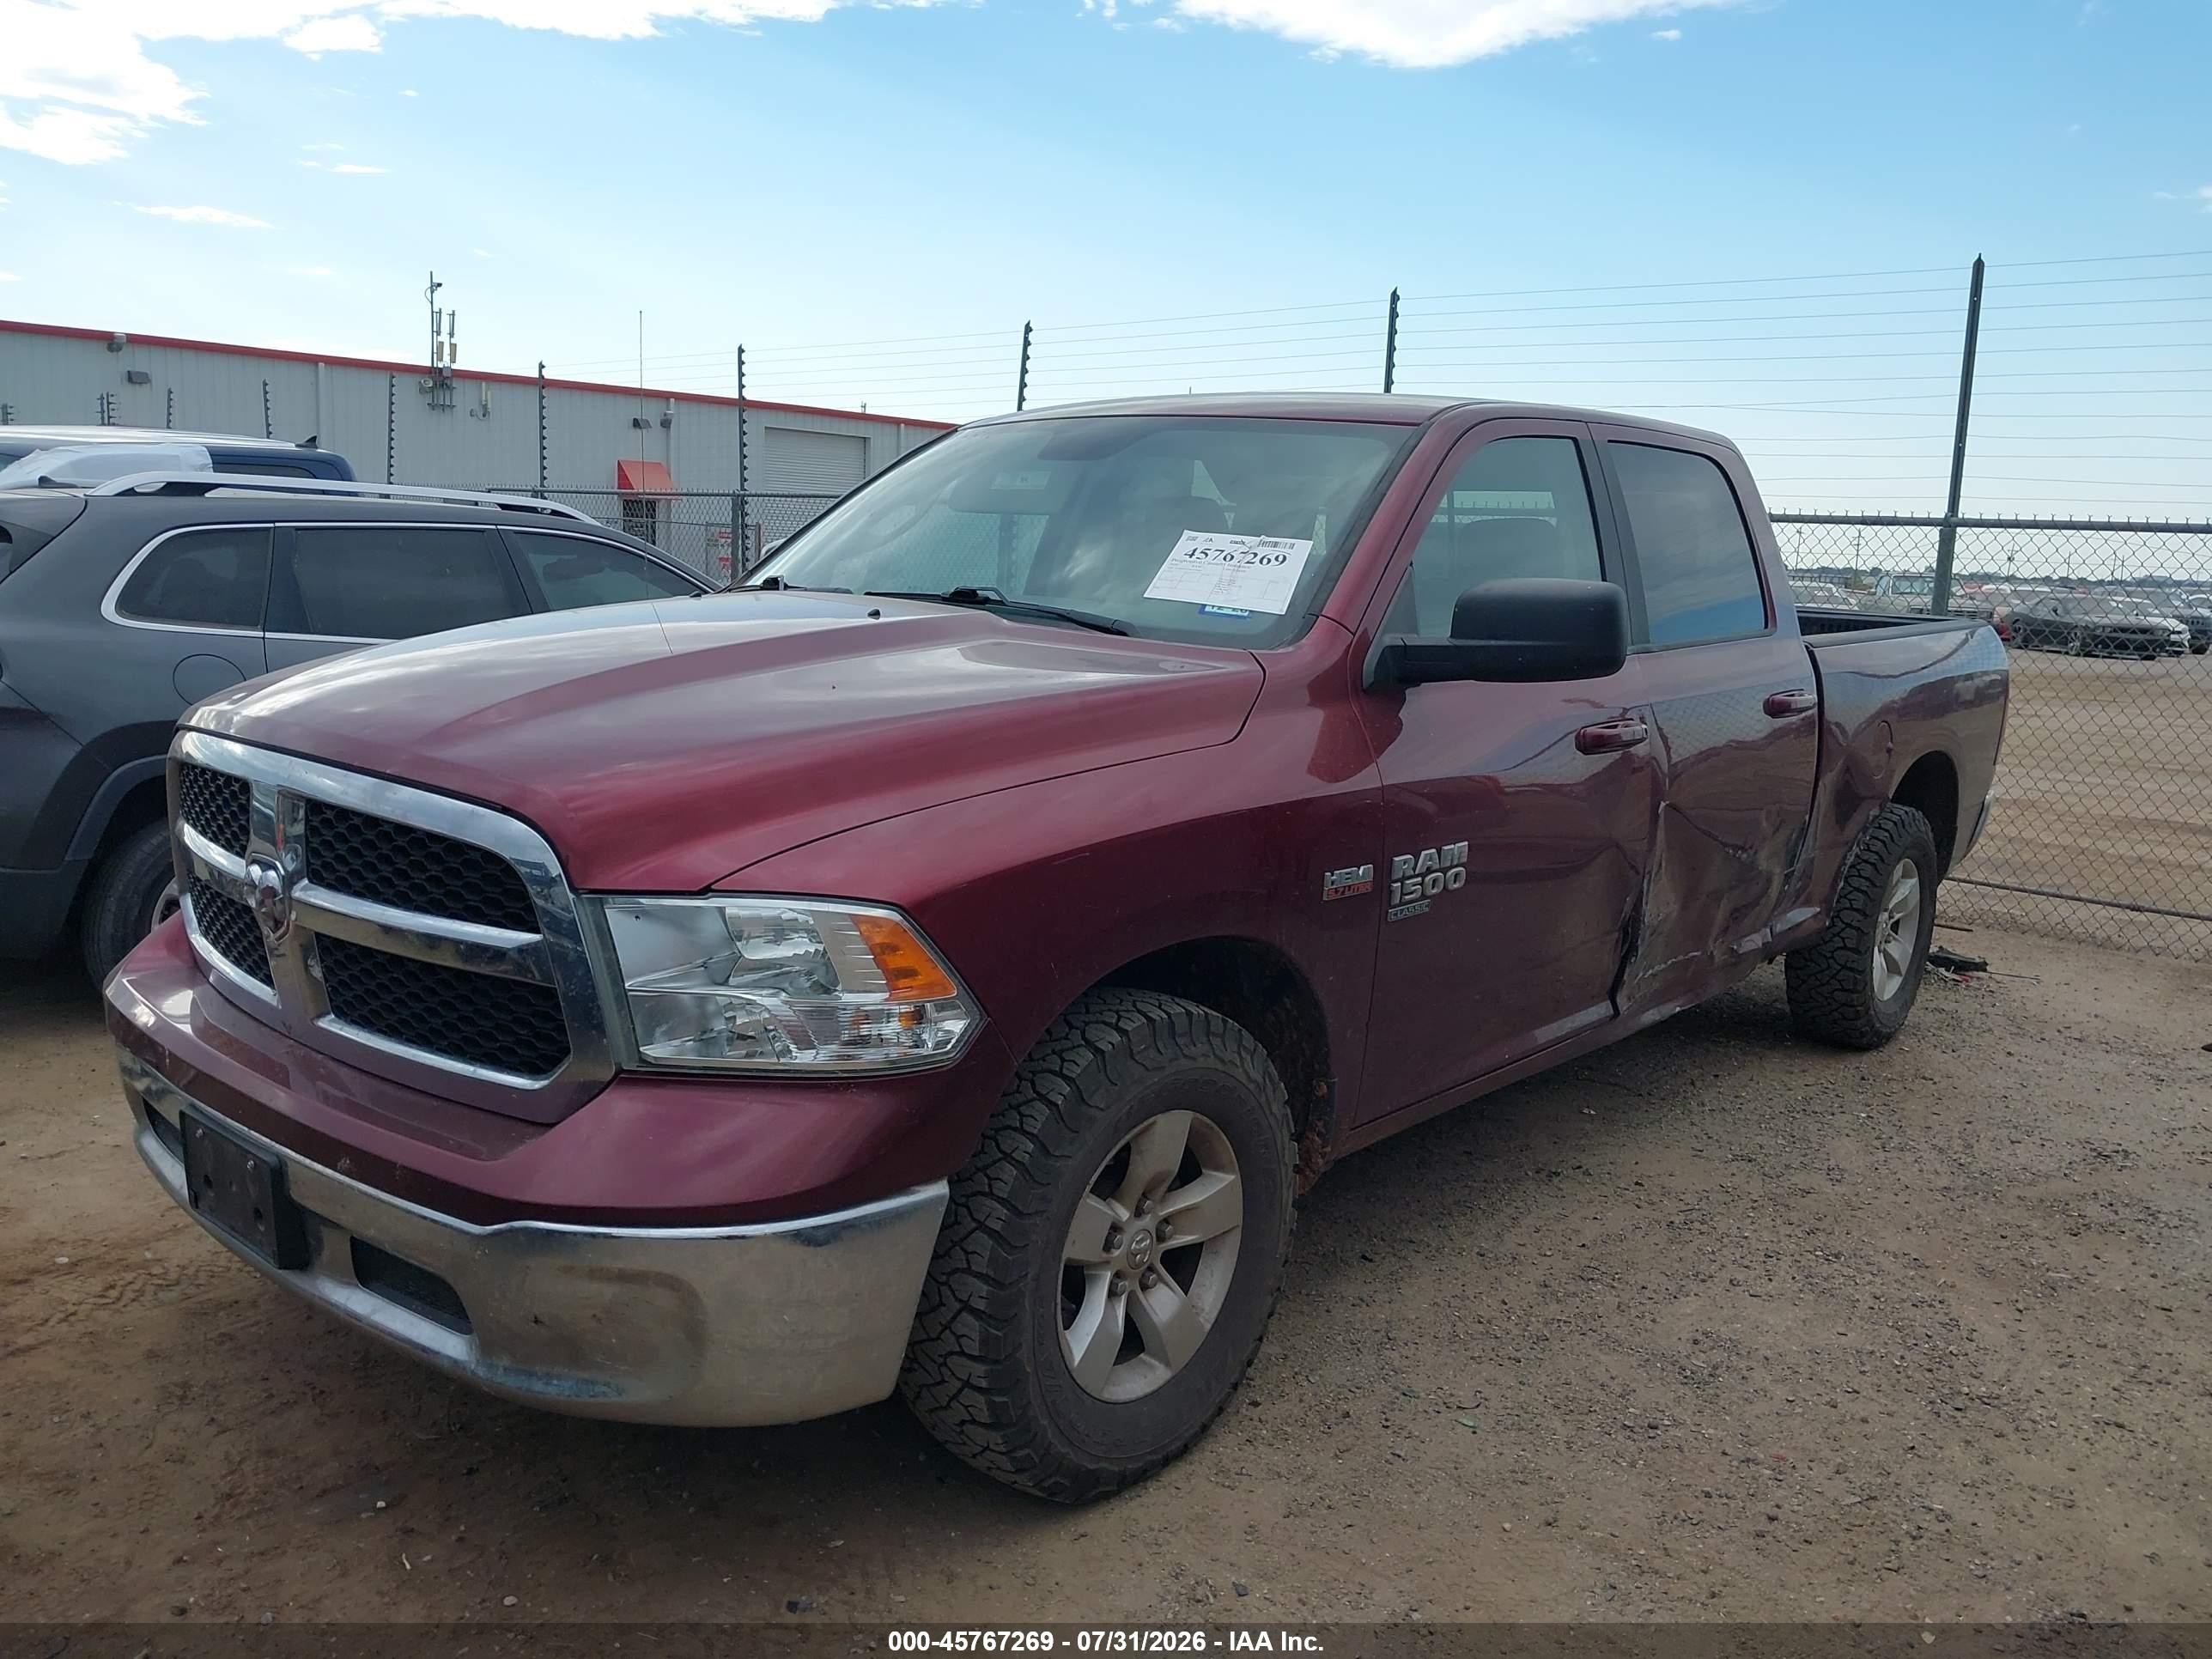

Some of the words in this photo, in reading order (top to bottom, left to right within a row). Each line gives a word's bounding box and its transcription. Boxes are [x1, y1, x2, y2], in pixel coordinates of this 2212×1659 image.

[1183, 547, 1288, 567] 45767269
[1392, 842, 1469, 879] RAM
[1328, 887, 1343, 897] 5.7
[1345, 883, 1371, 894] LITER
[1390, 866, 1467, 906] 1500
[1390, 902, 1430, 920] CLASSIC
